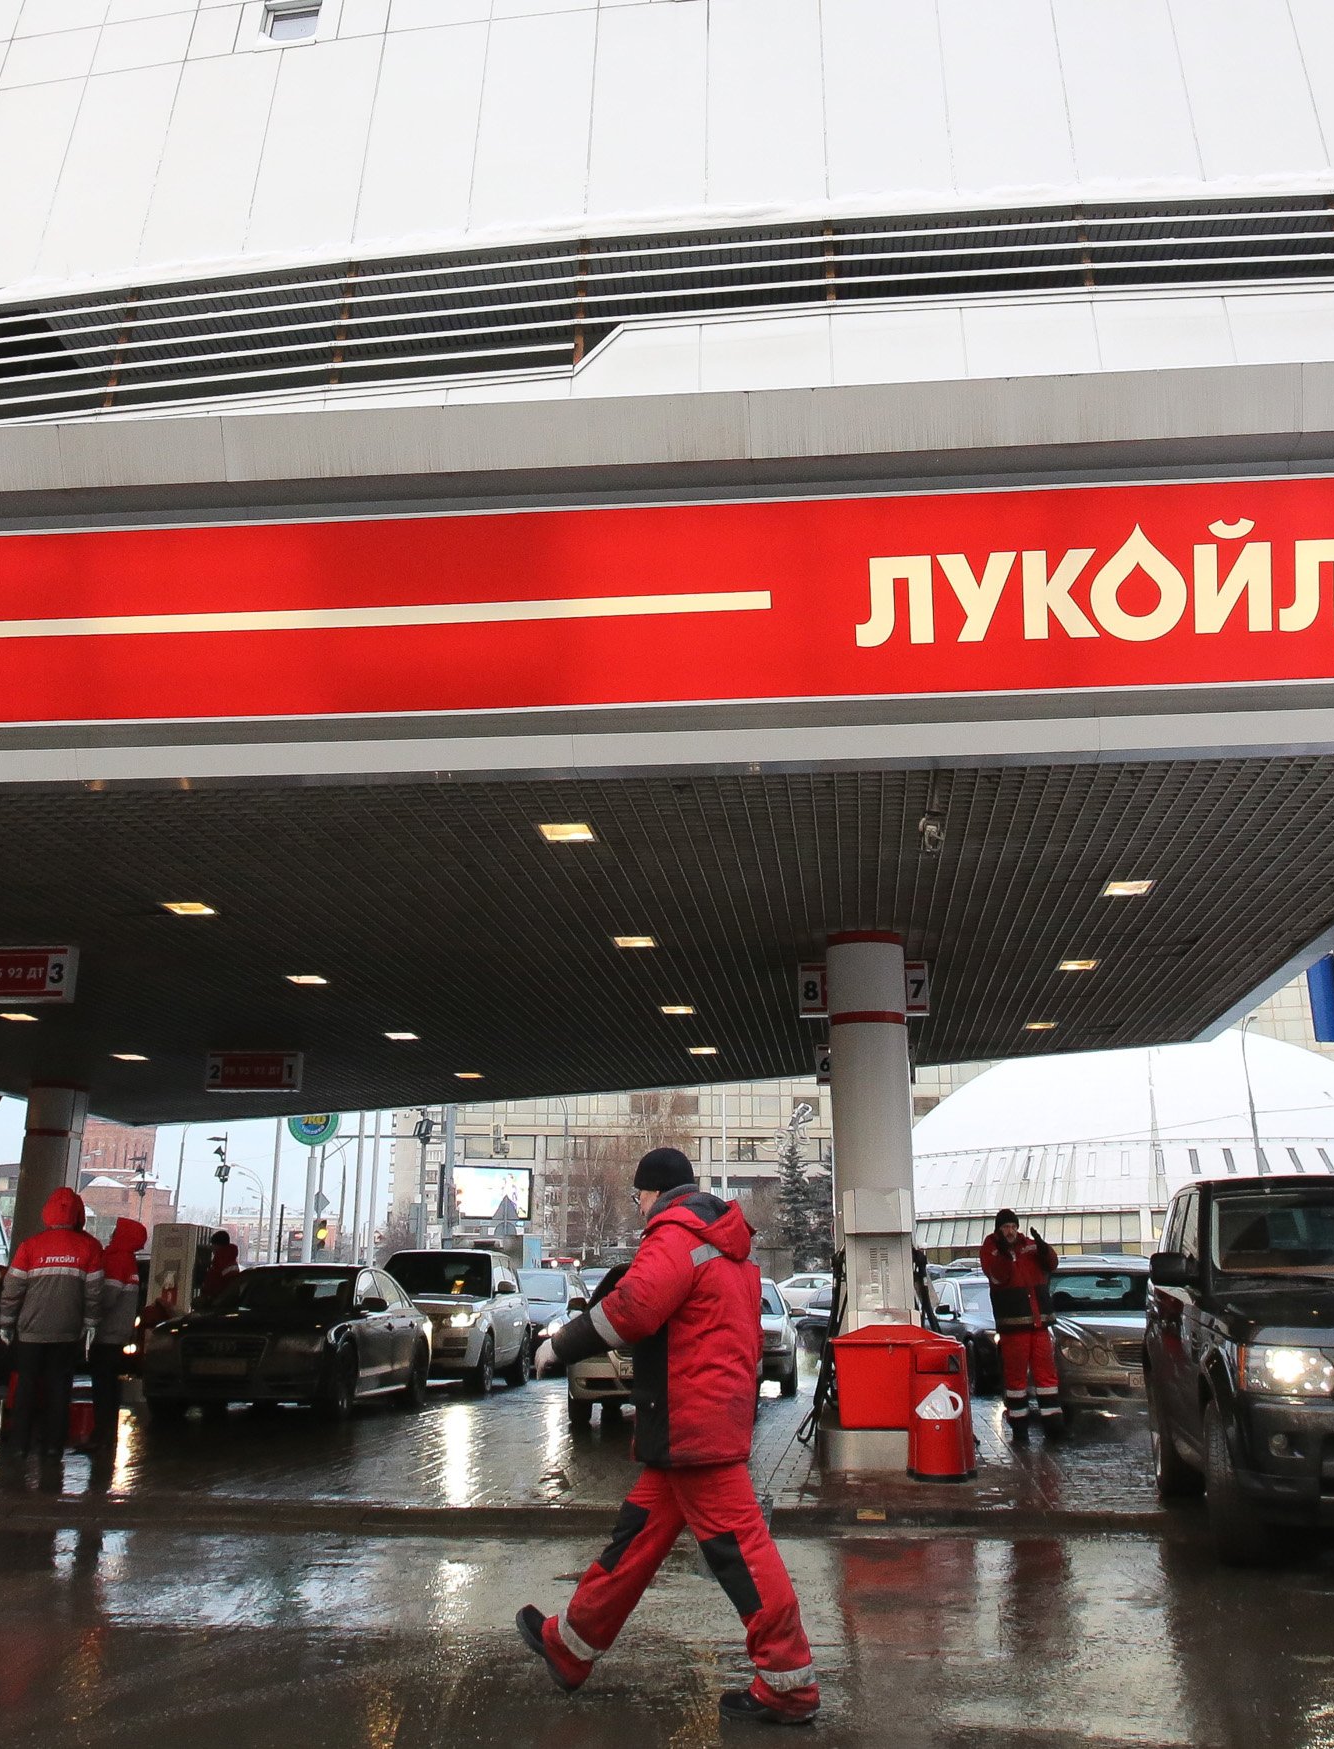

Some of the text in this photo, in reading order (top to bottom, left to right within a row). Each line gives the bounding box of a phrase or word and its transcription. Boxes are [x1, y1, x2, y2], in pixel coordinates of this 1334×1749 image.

[8, 967, 23, 979] 92
[27, 967, 44, 980] ДТ
[49, 963, 64, 984] 3
[803, 980, 818, 1001] 8
[910, 979, 925, 999] 7
[286, 1064, 294, 1079] 1
[45, 1254, 75, 1264] ЛУКОЙЛ
